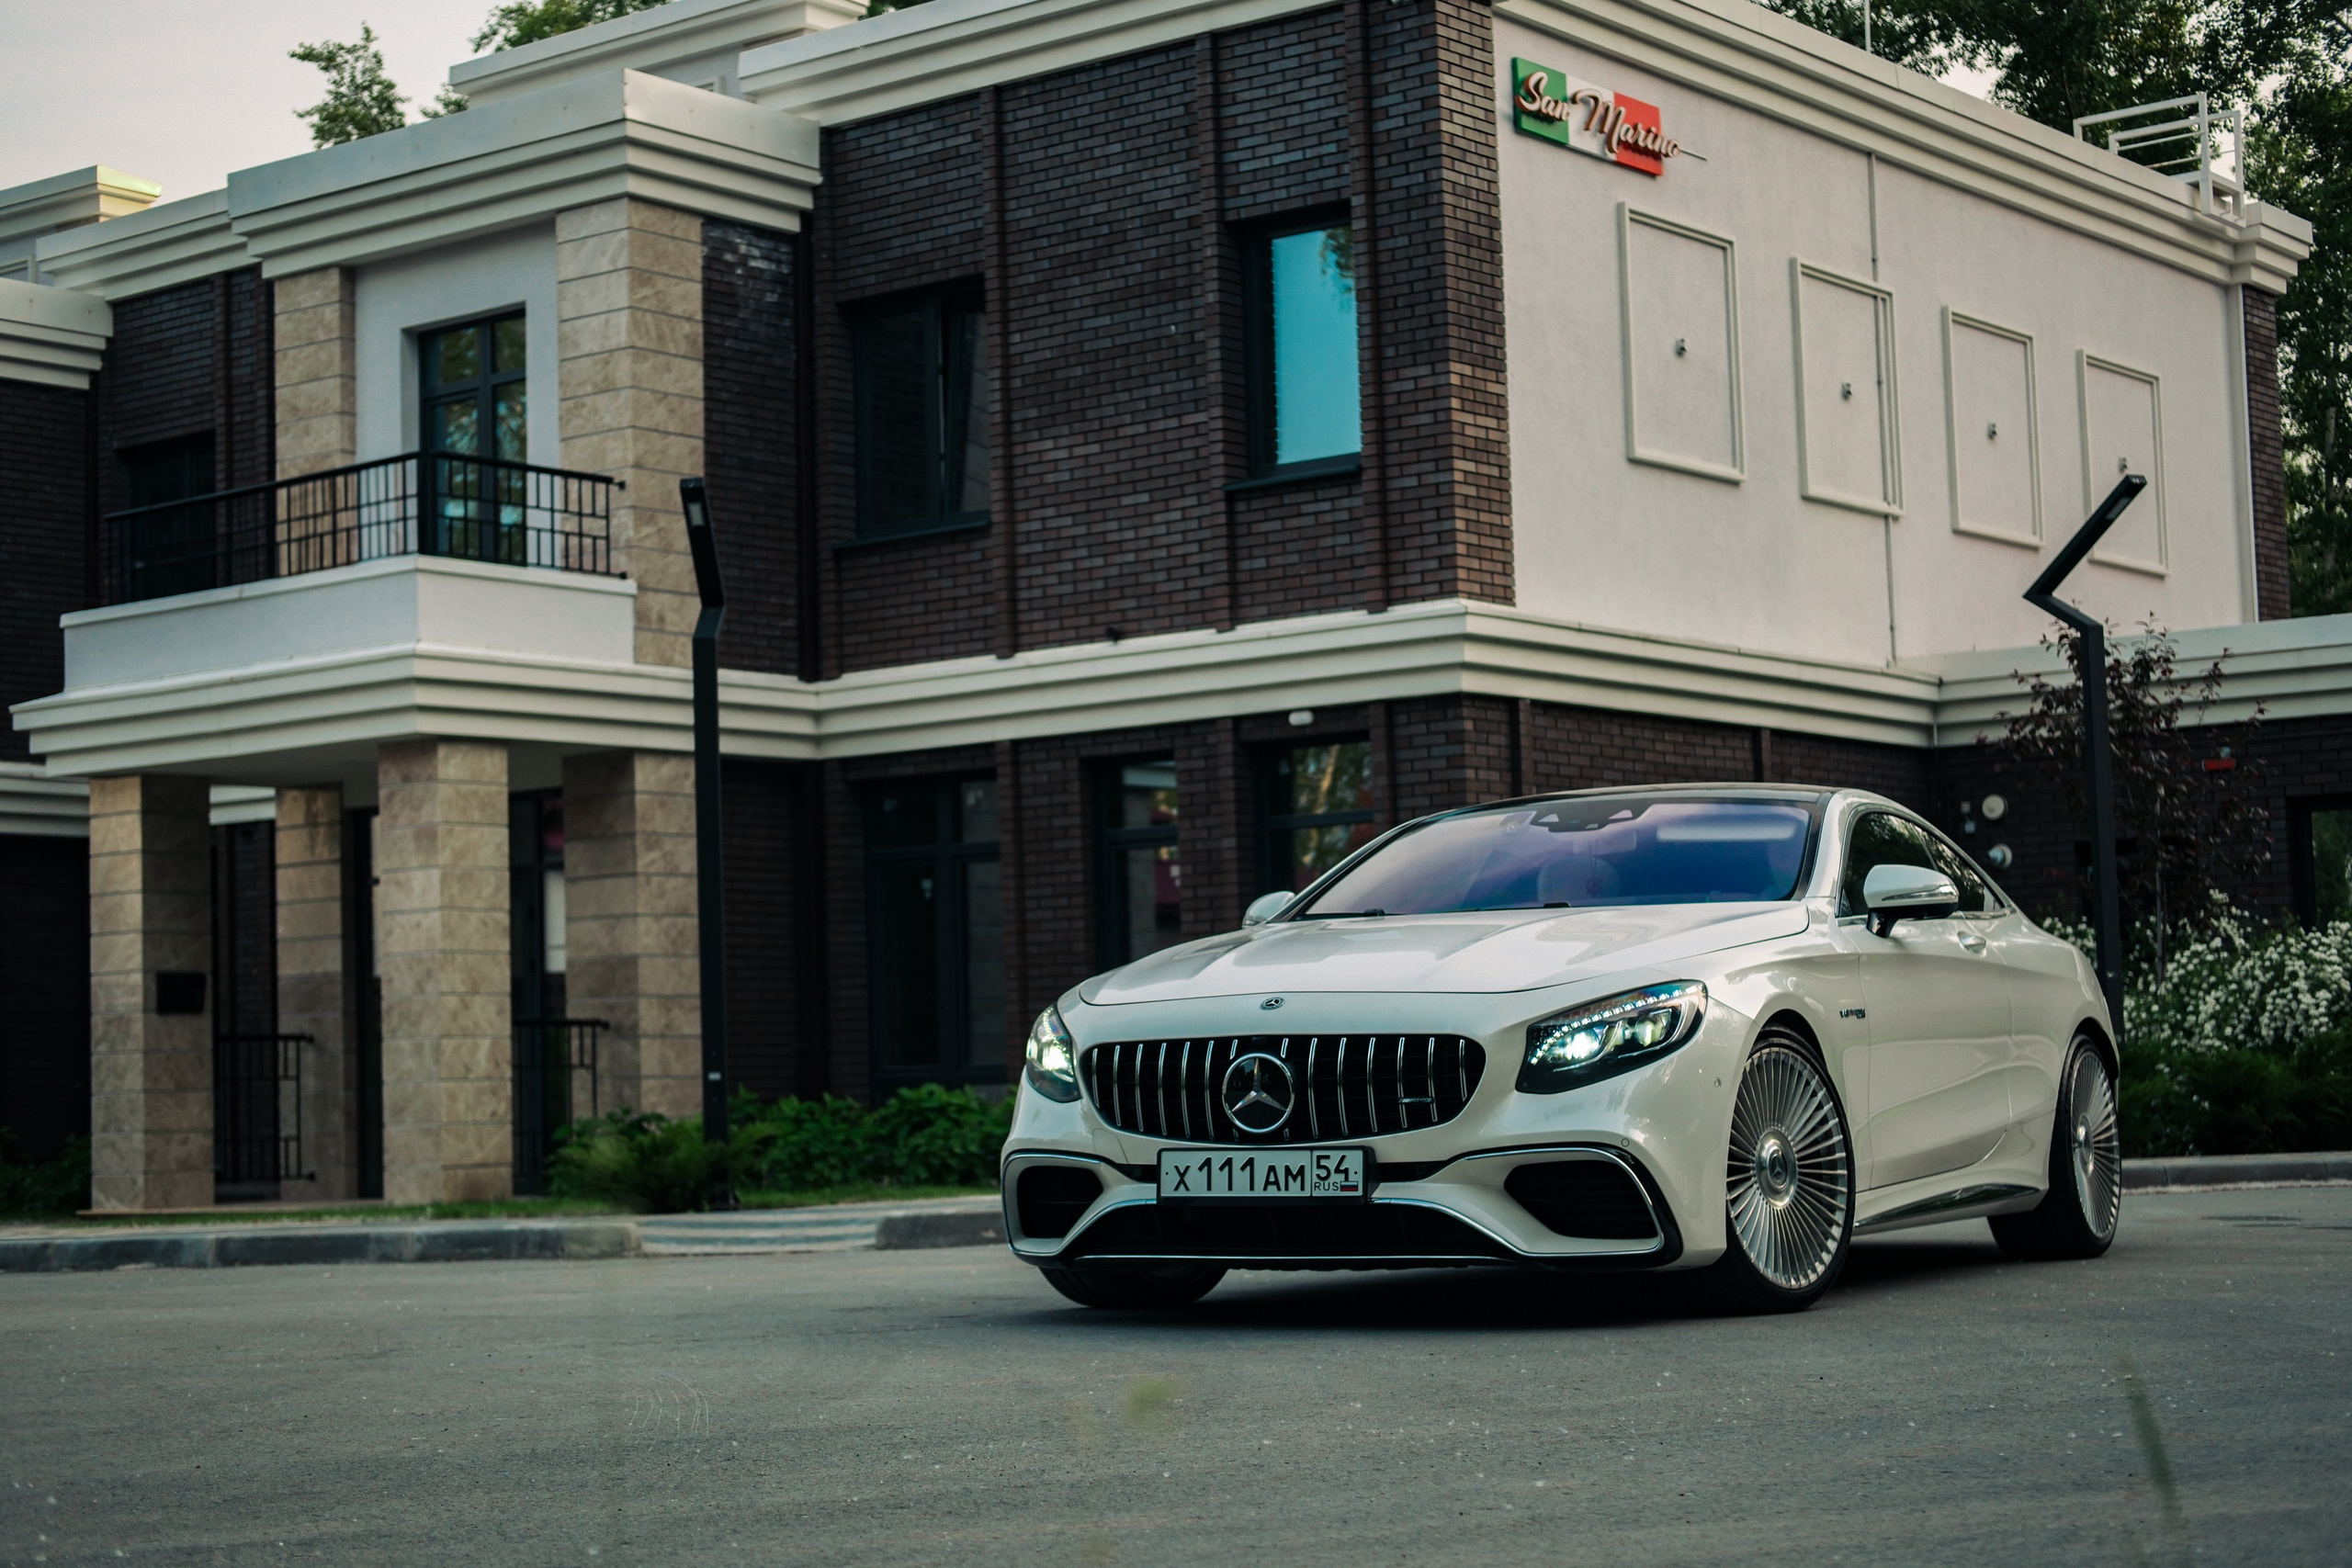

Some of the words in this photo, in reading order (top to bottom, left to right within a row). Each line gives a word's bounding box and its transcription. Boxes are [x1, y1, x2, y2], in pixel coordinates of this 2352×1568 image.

[1514, 71, 1571, 121] San
[1570, 87, 1682, 159] Marino
[1316, 1155, 1350, 1182] 54
[1314, 1182, 1339, 1192] RUS
